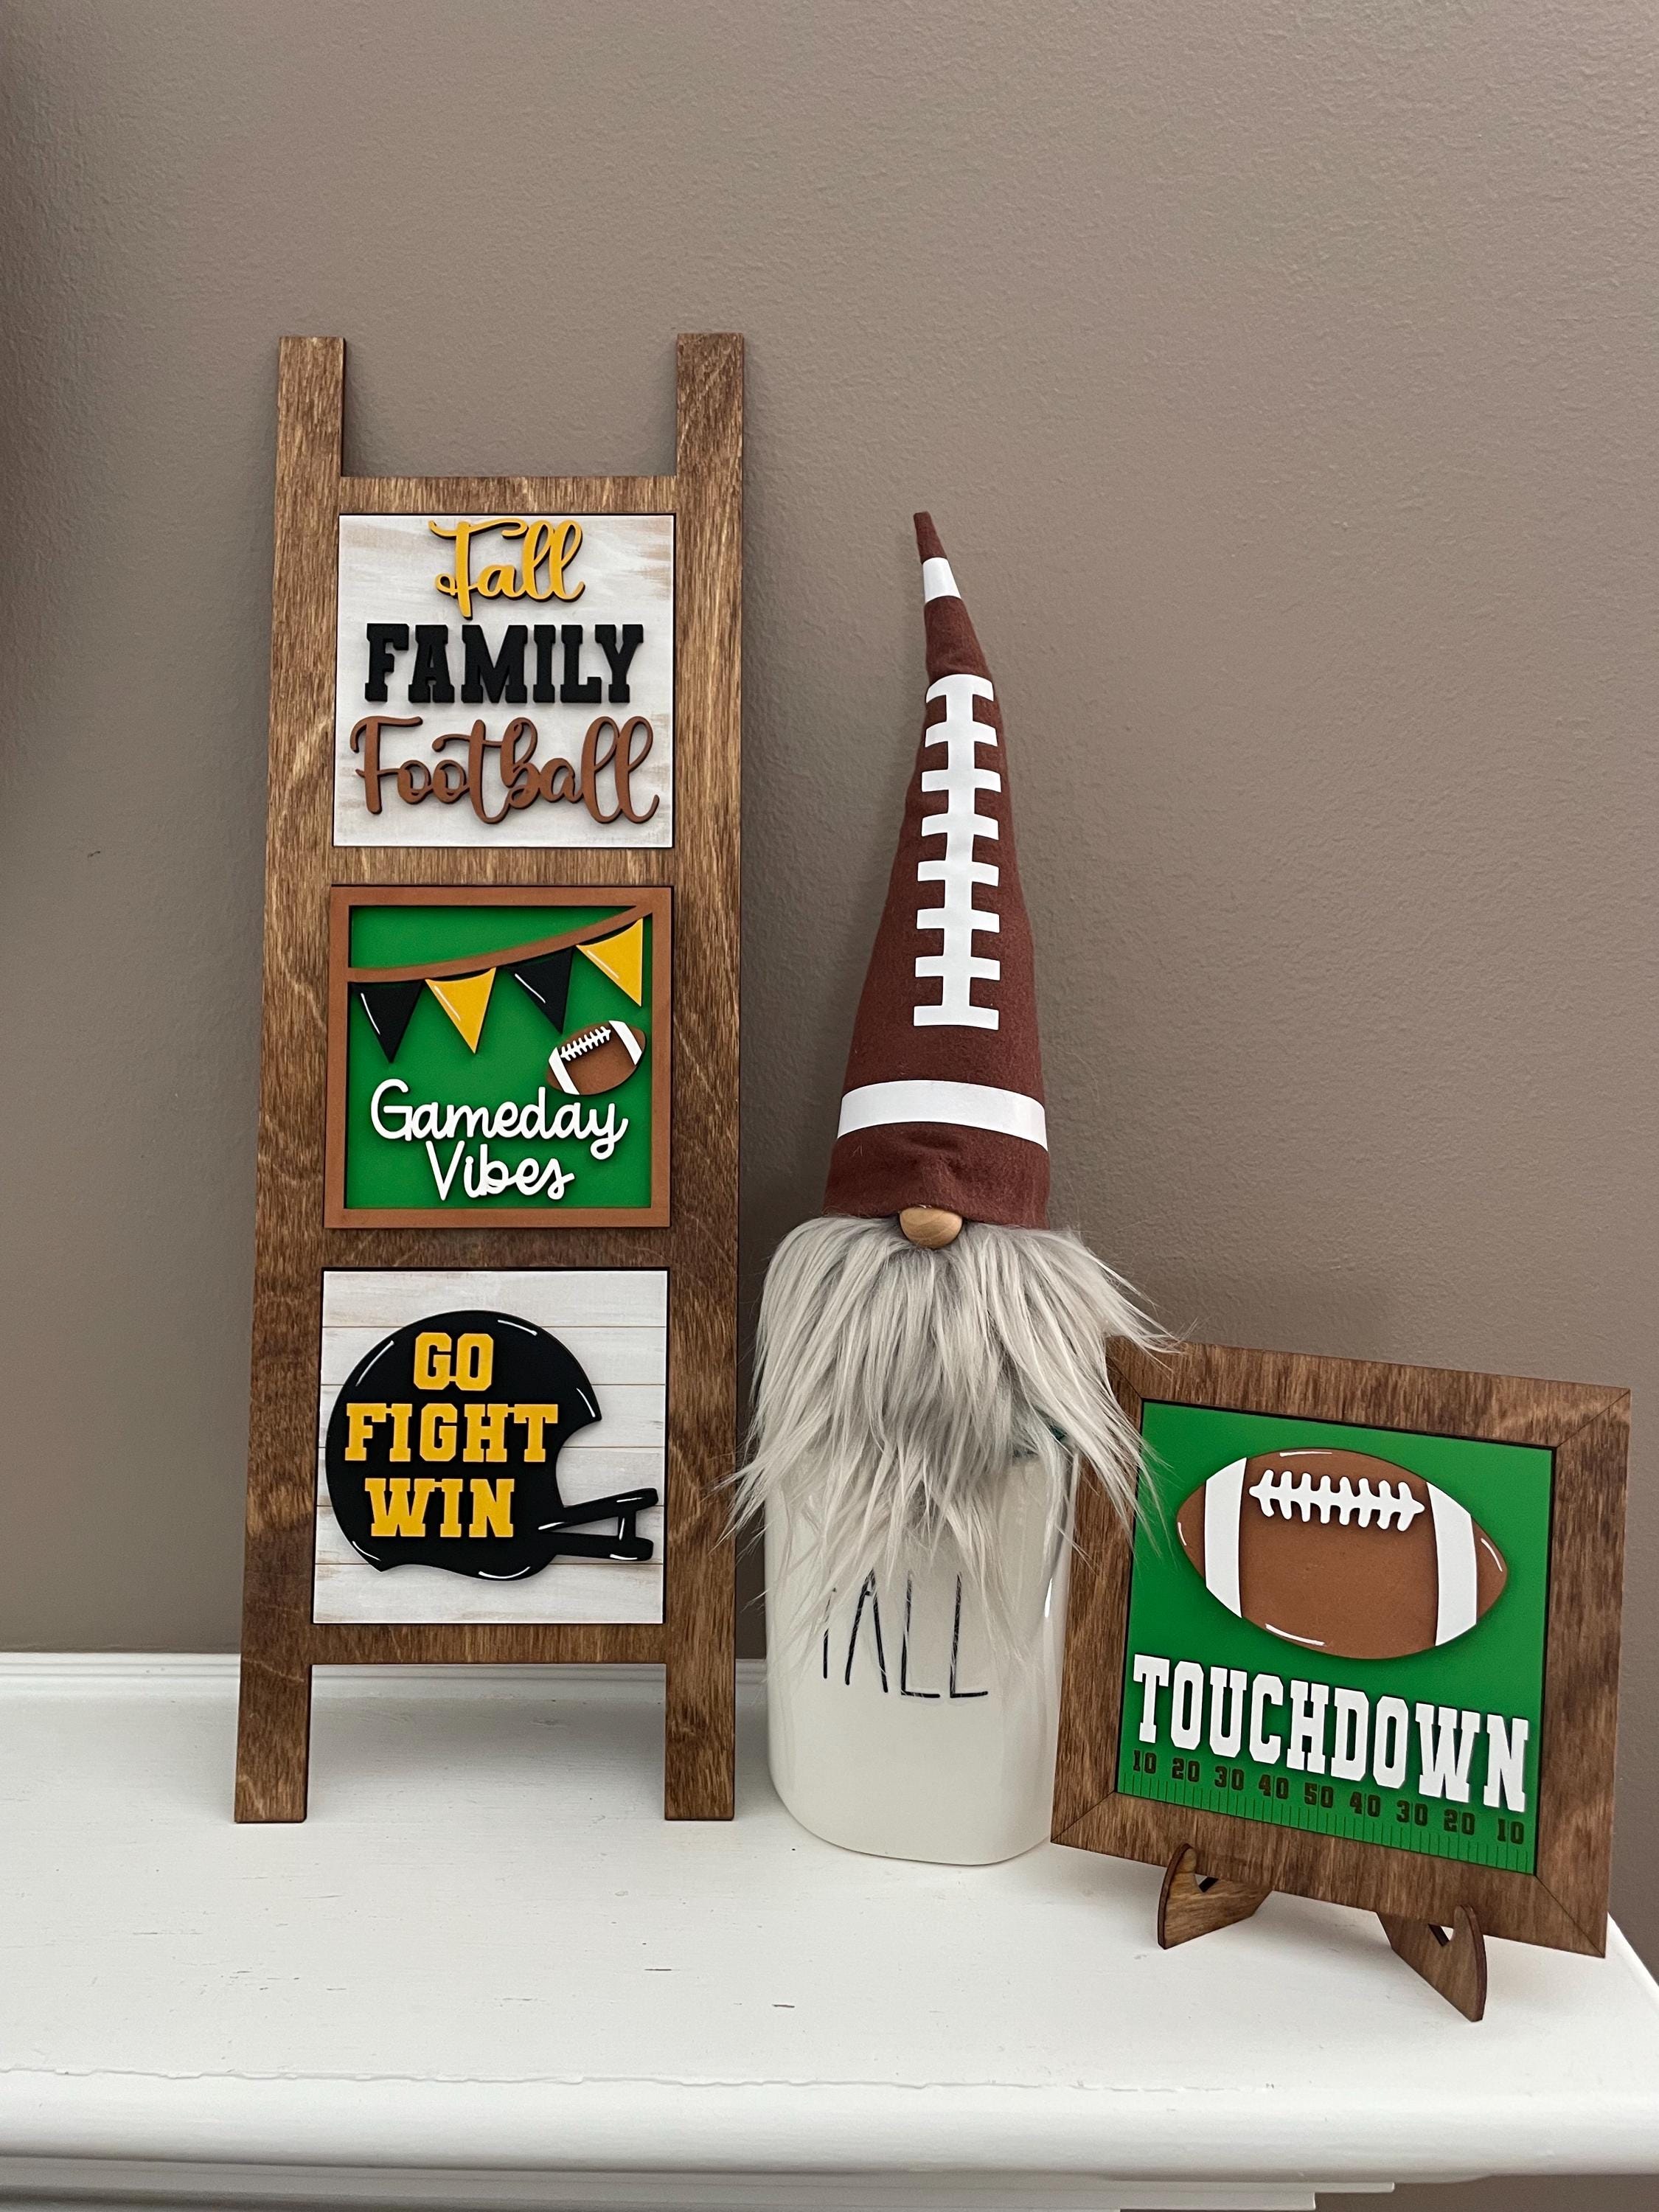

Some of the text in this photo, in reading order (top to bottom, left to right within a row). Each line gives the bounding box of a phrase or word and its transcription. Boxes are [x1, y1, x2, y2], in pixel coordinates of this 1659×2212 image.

[428, 518, 585, 620] Fall
[365, 623, 644, 703] FAMILY
[349, 715, 660, 824] Football
[371, 1078, 629, 1160] Gameday
[425, 1140, 575, 1201] Vibes
[413, 1332, 494, 1392] GO
[344, 1402, 559, 1463] FIGHT
[364, 1478, 515, 1538] WIN
[822, 1568, 989, 1699] ALL
[1133, 1653, 1529, 1813] TOUCHDOWN
[1133, 1750, 1524, 1845] 10 20 30 40 50 40 30 20 10
